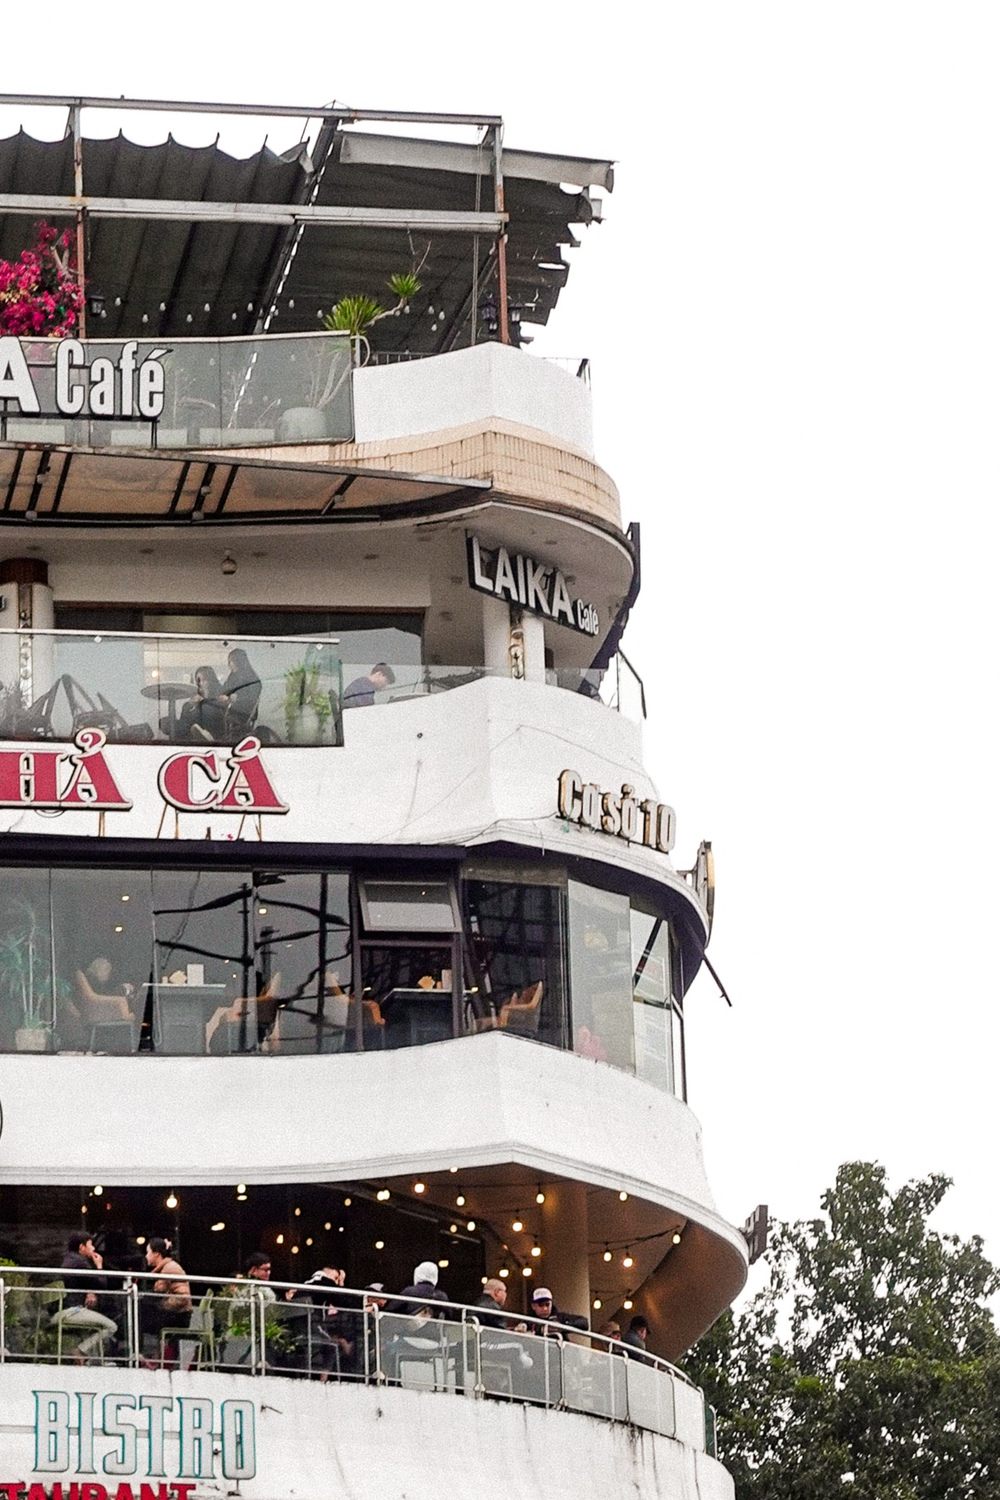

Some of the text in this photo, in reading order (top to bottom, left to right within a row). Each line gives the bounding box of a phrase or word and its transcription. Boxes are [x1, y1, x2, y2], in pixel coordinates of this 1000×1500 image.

[55, 337, 174, 420] Café
[470, 535, 600, 636] LAIKA Café
[157, 737, 291, 815] CÁ
[641, 799, 677, 852] 10
[31, 1390, 257, 1480] BISTRO
